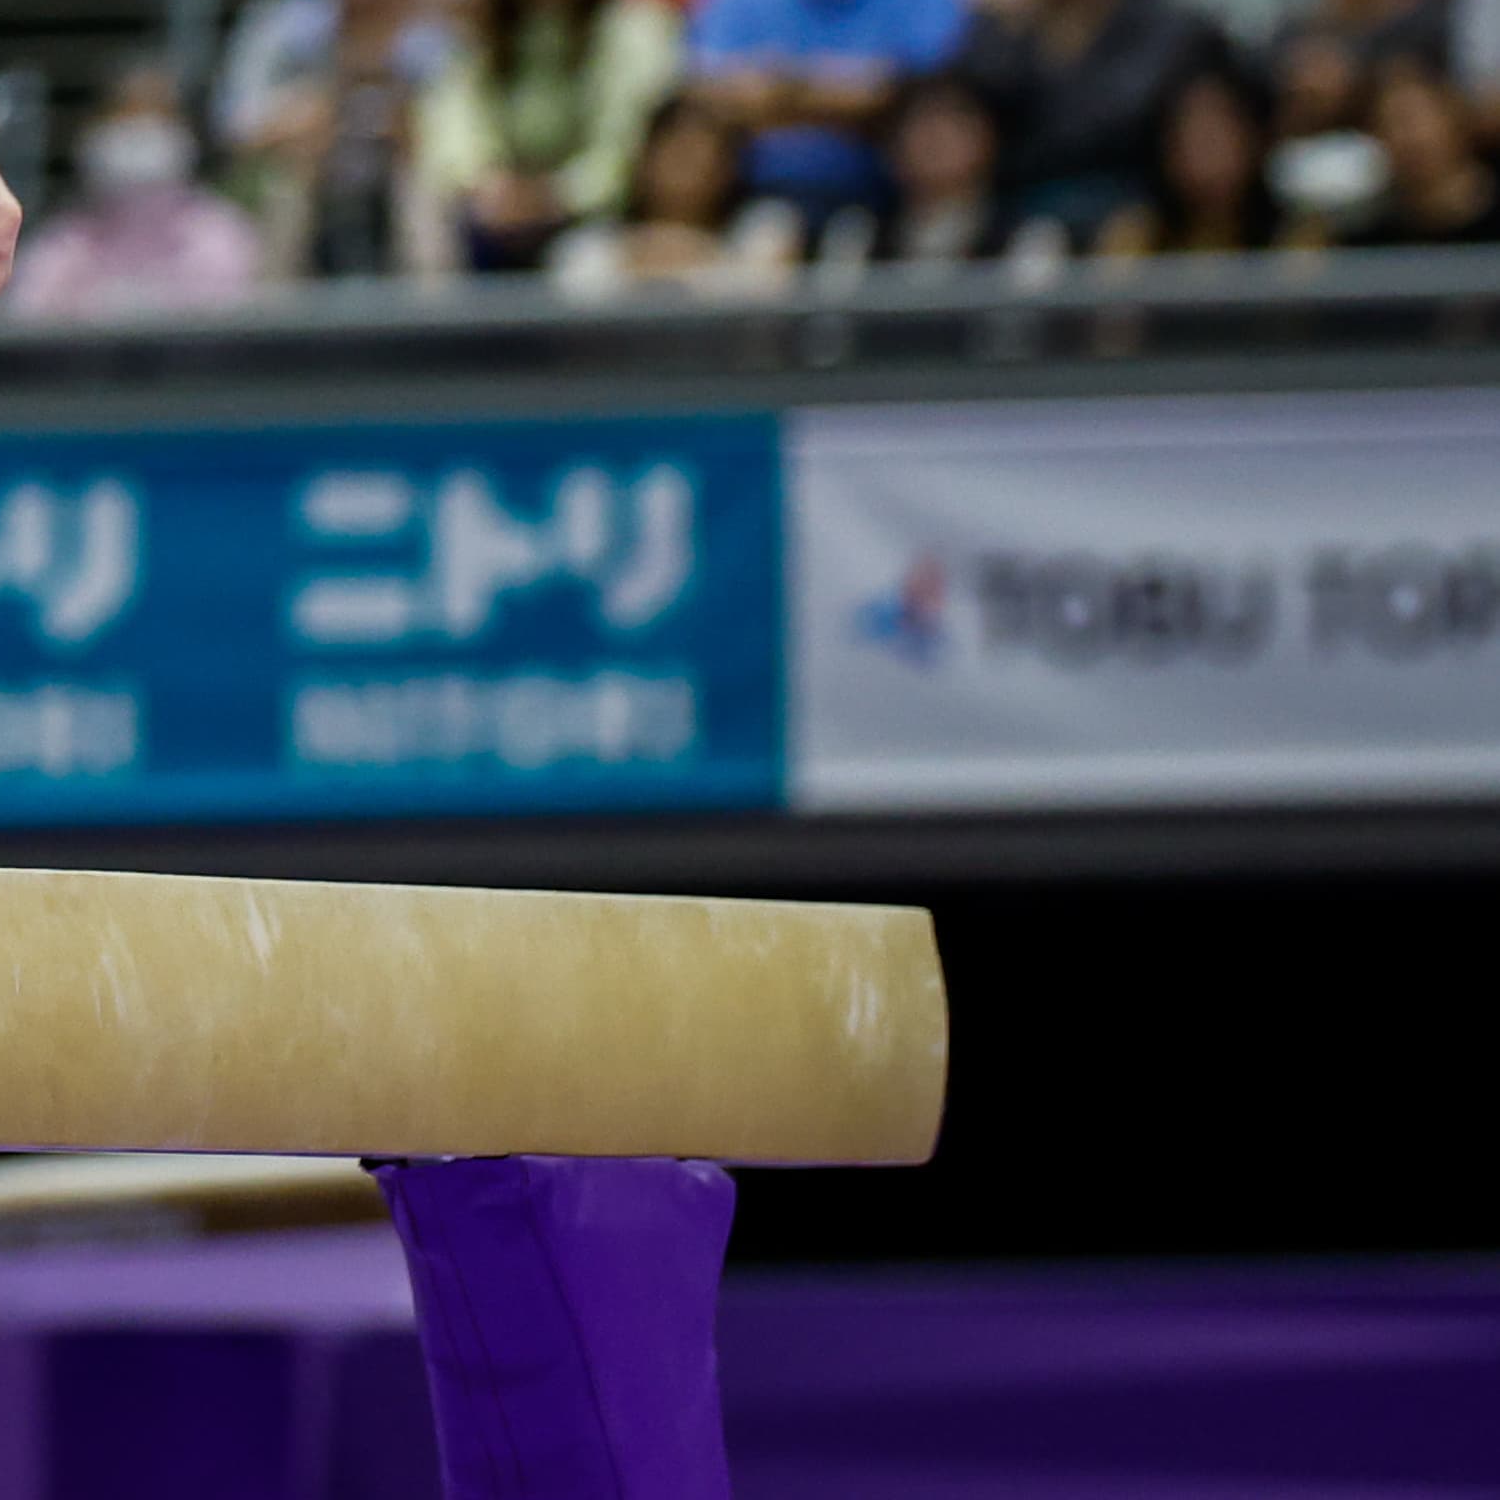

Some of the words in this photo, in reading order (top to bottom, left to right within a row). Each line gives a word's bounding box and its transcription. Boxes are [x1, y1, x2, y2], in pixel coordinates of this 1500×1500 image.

[292, 462, 695, 642] ニトリ
[980, 545, 1278, 670] TOBU
